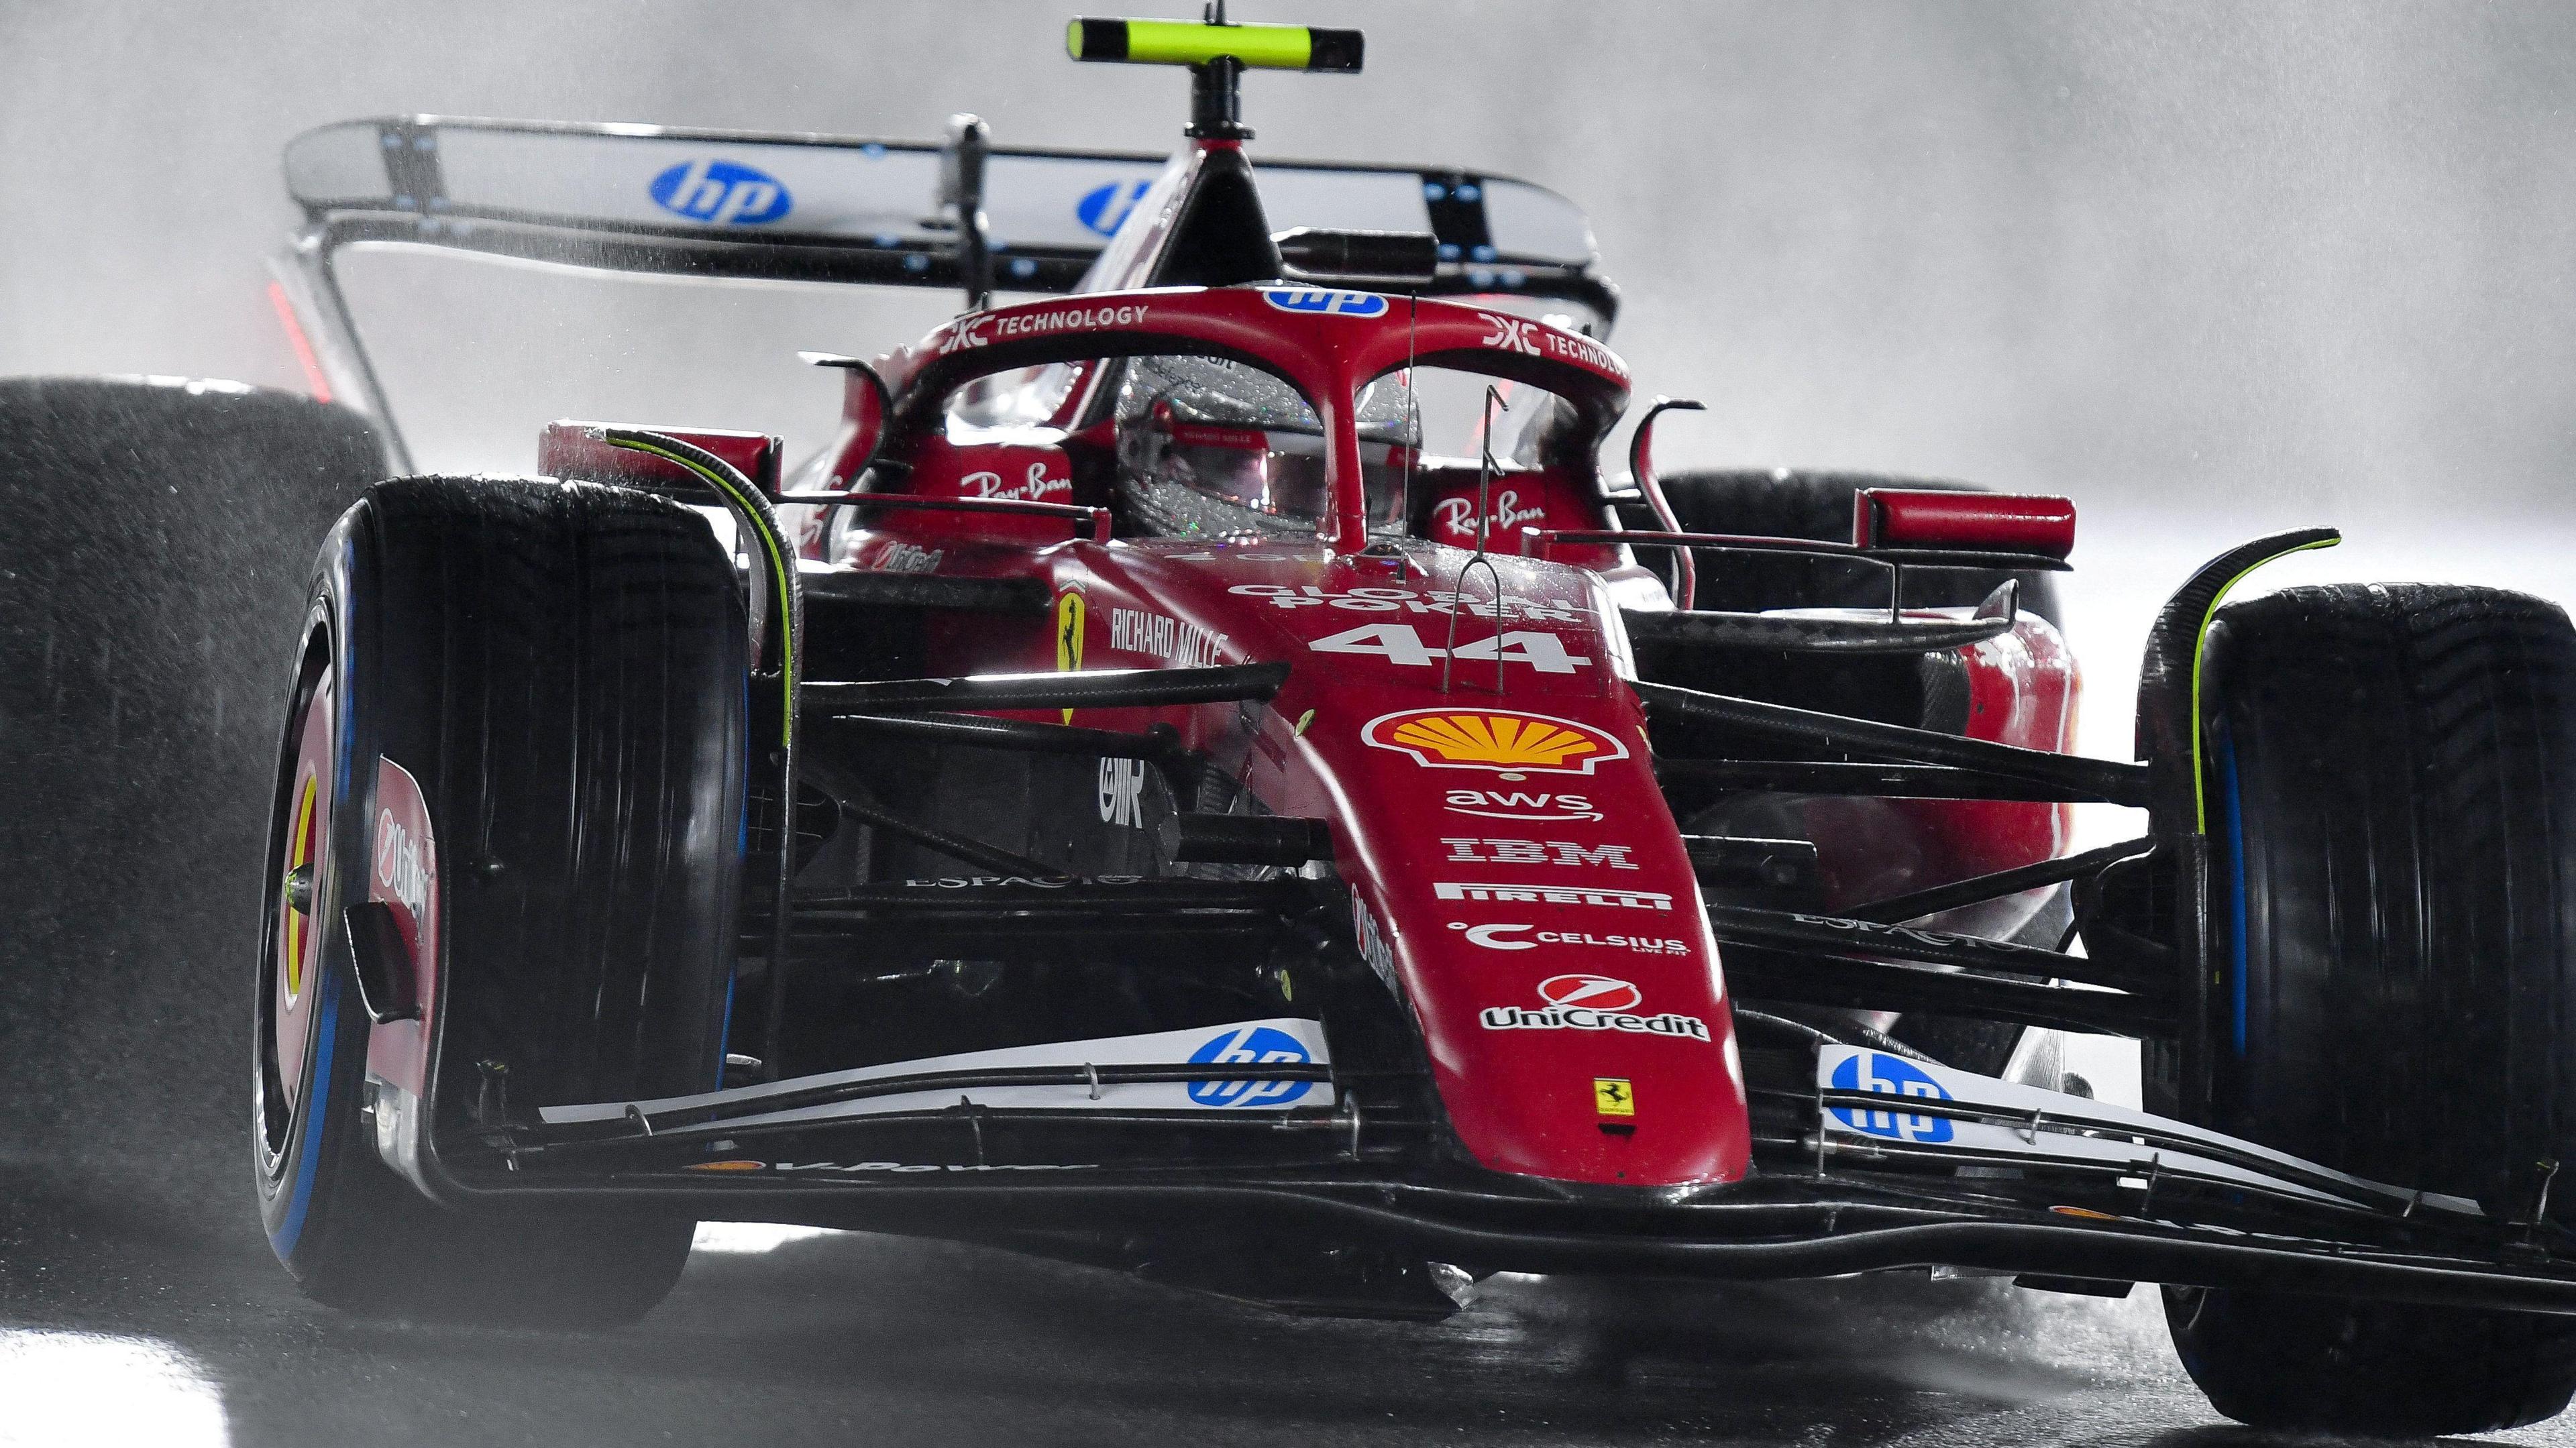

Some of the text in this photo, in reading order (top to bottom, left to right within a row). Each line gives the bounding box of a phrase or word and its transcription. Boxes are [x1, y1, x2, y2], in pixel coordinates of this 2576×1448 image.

[671, 160, 782, 224] hp
[997, 305, 1148, 335] TECHNOLOGY
[1478, 313, 1541, 355] DXC
[1434, 490, 1546, 537] Ray-Ban
[1228, 585, 1599, 615] GLOBAL
[1269, 596, 1582, 622] POKER
[1111, 608, 1229, 668] RICHARD MILLE
[1308, 623, 1593, 673] 44
[1446, 790, 1593, 811] aws
[1440, 837, 1640, 870] IBM
[1432, 882, 1673, 911] PIRELLI
[1537, 931, 1688, 952] CELSIUS
[1483, 1007, 1708, 1040] UniCredit
[1197, 1026, 1303, 1106] hp
[1850, 1052, 1942, 1141] hp
